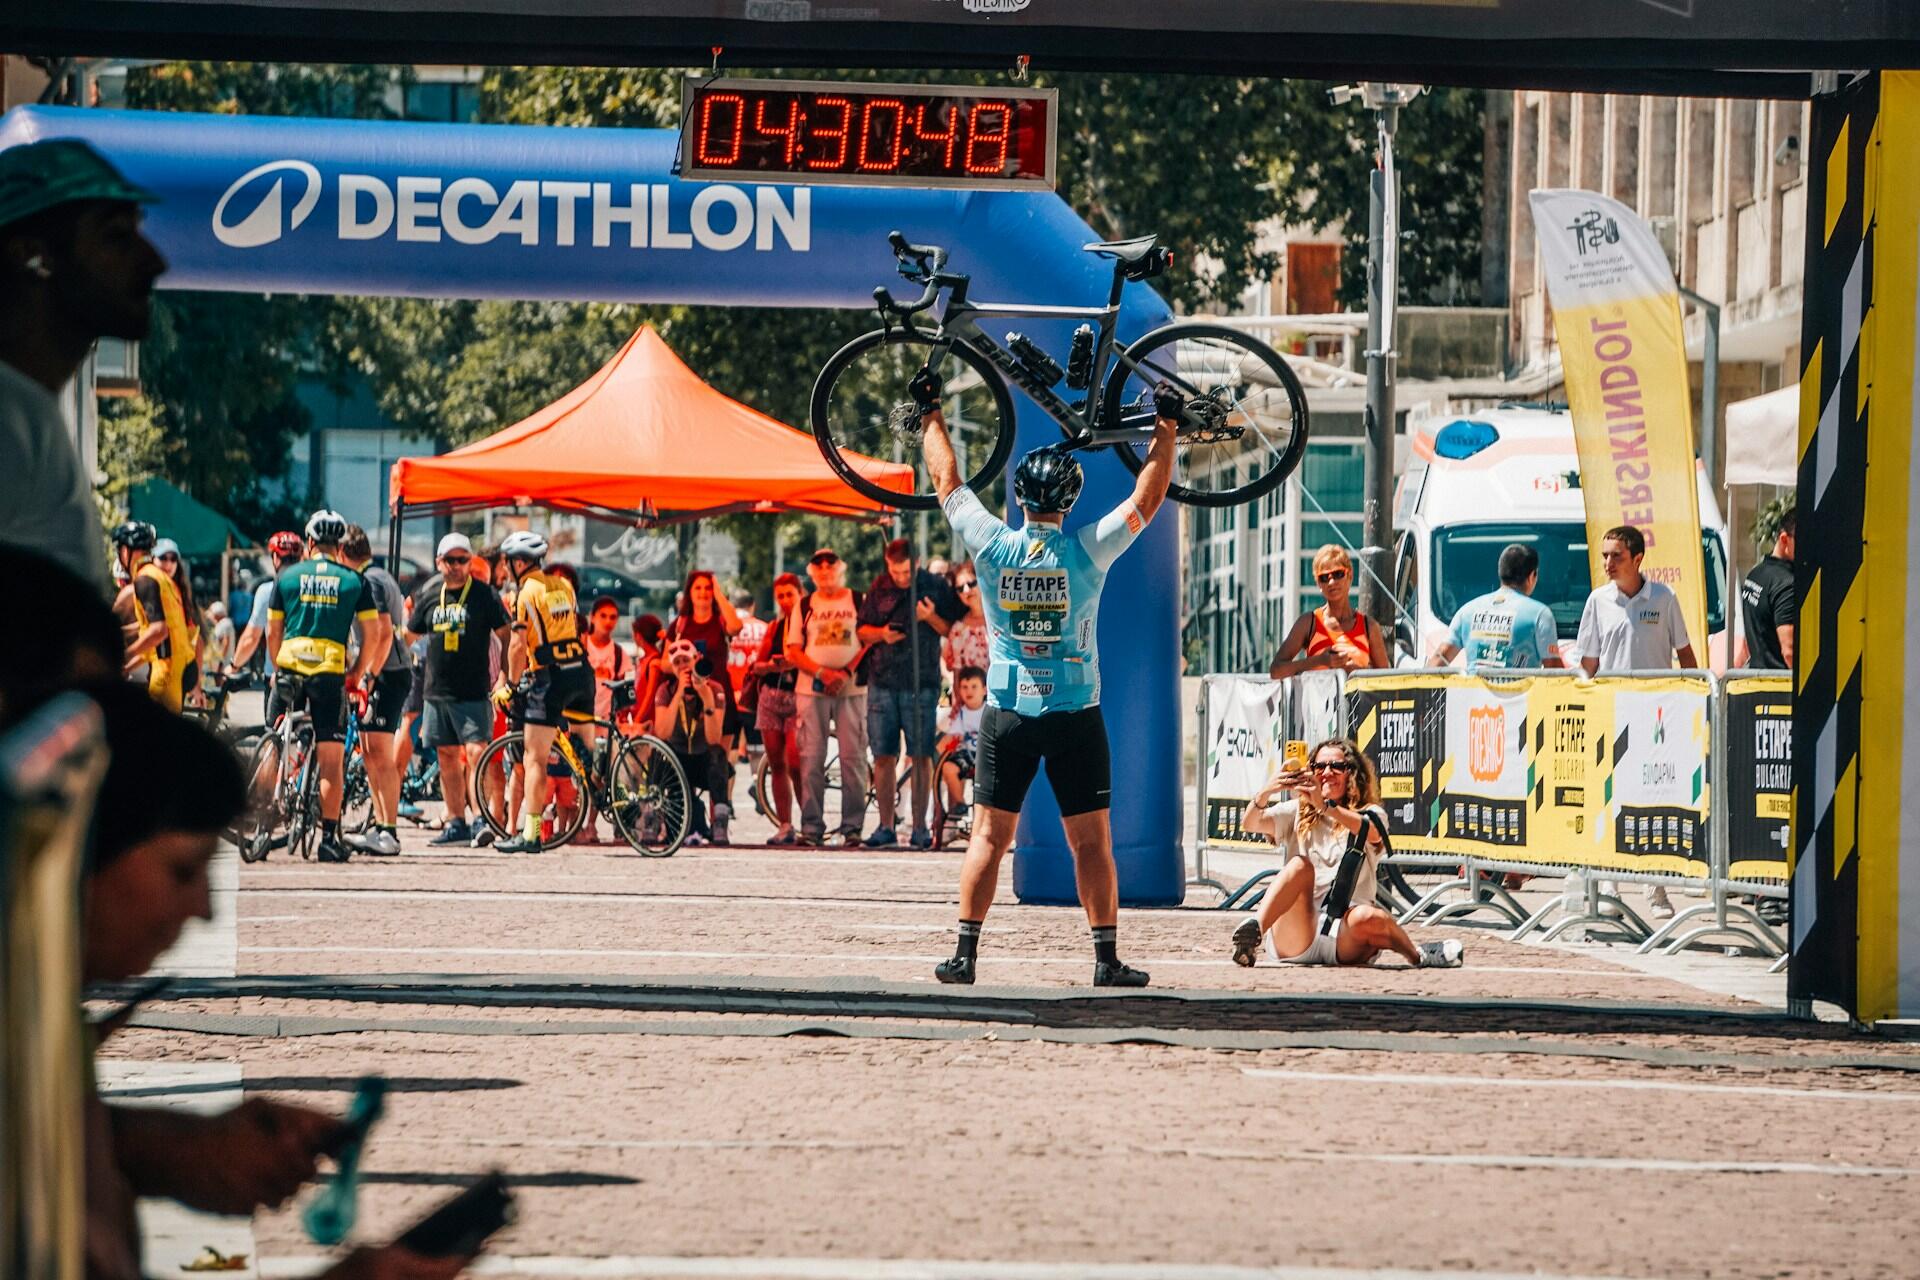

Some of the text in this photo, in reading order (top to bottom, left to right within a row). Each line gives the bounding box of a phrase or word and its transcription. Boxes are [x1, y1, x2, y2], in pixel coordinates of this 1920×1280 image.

[698, 94, 1011, 173] 04:30:48
[338, 174, 811, 252] DECATHLON
[1001, 571, 1066, 592] L'ÉTAPE
[1000, 591, 1067, 602] BULGARIA
[1017, 620, 1053, 632] 1306
[1380, 750, 1415, 774] BULGARIA
